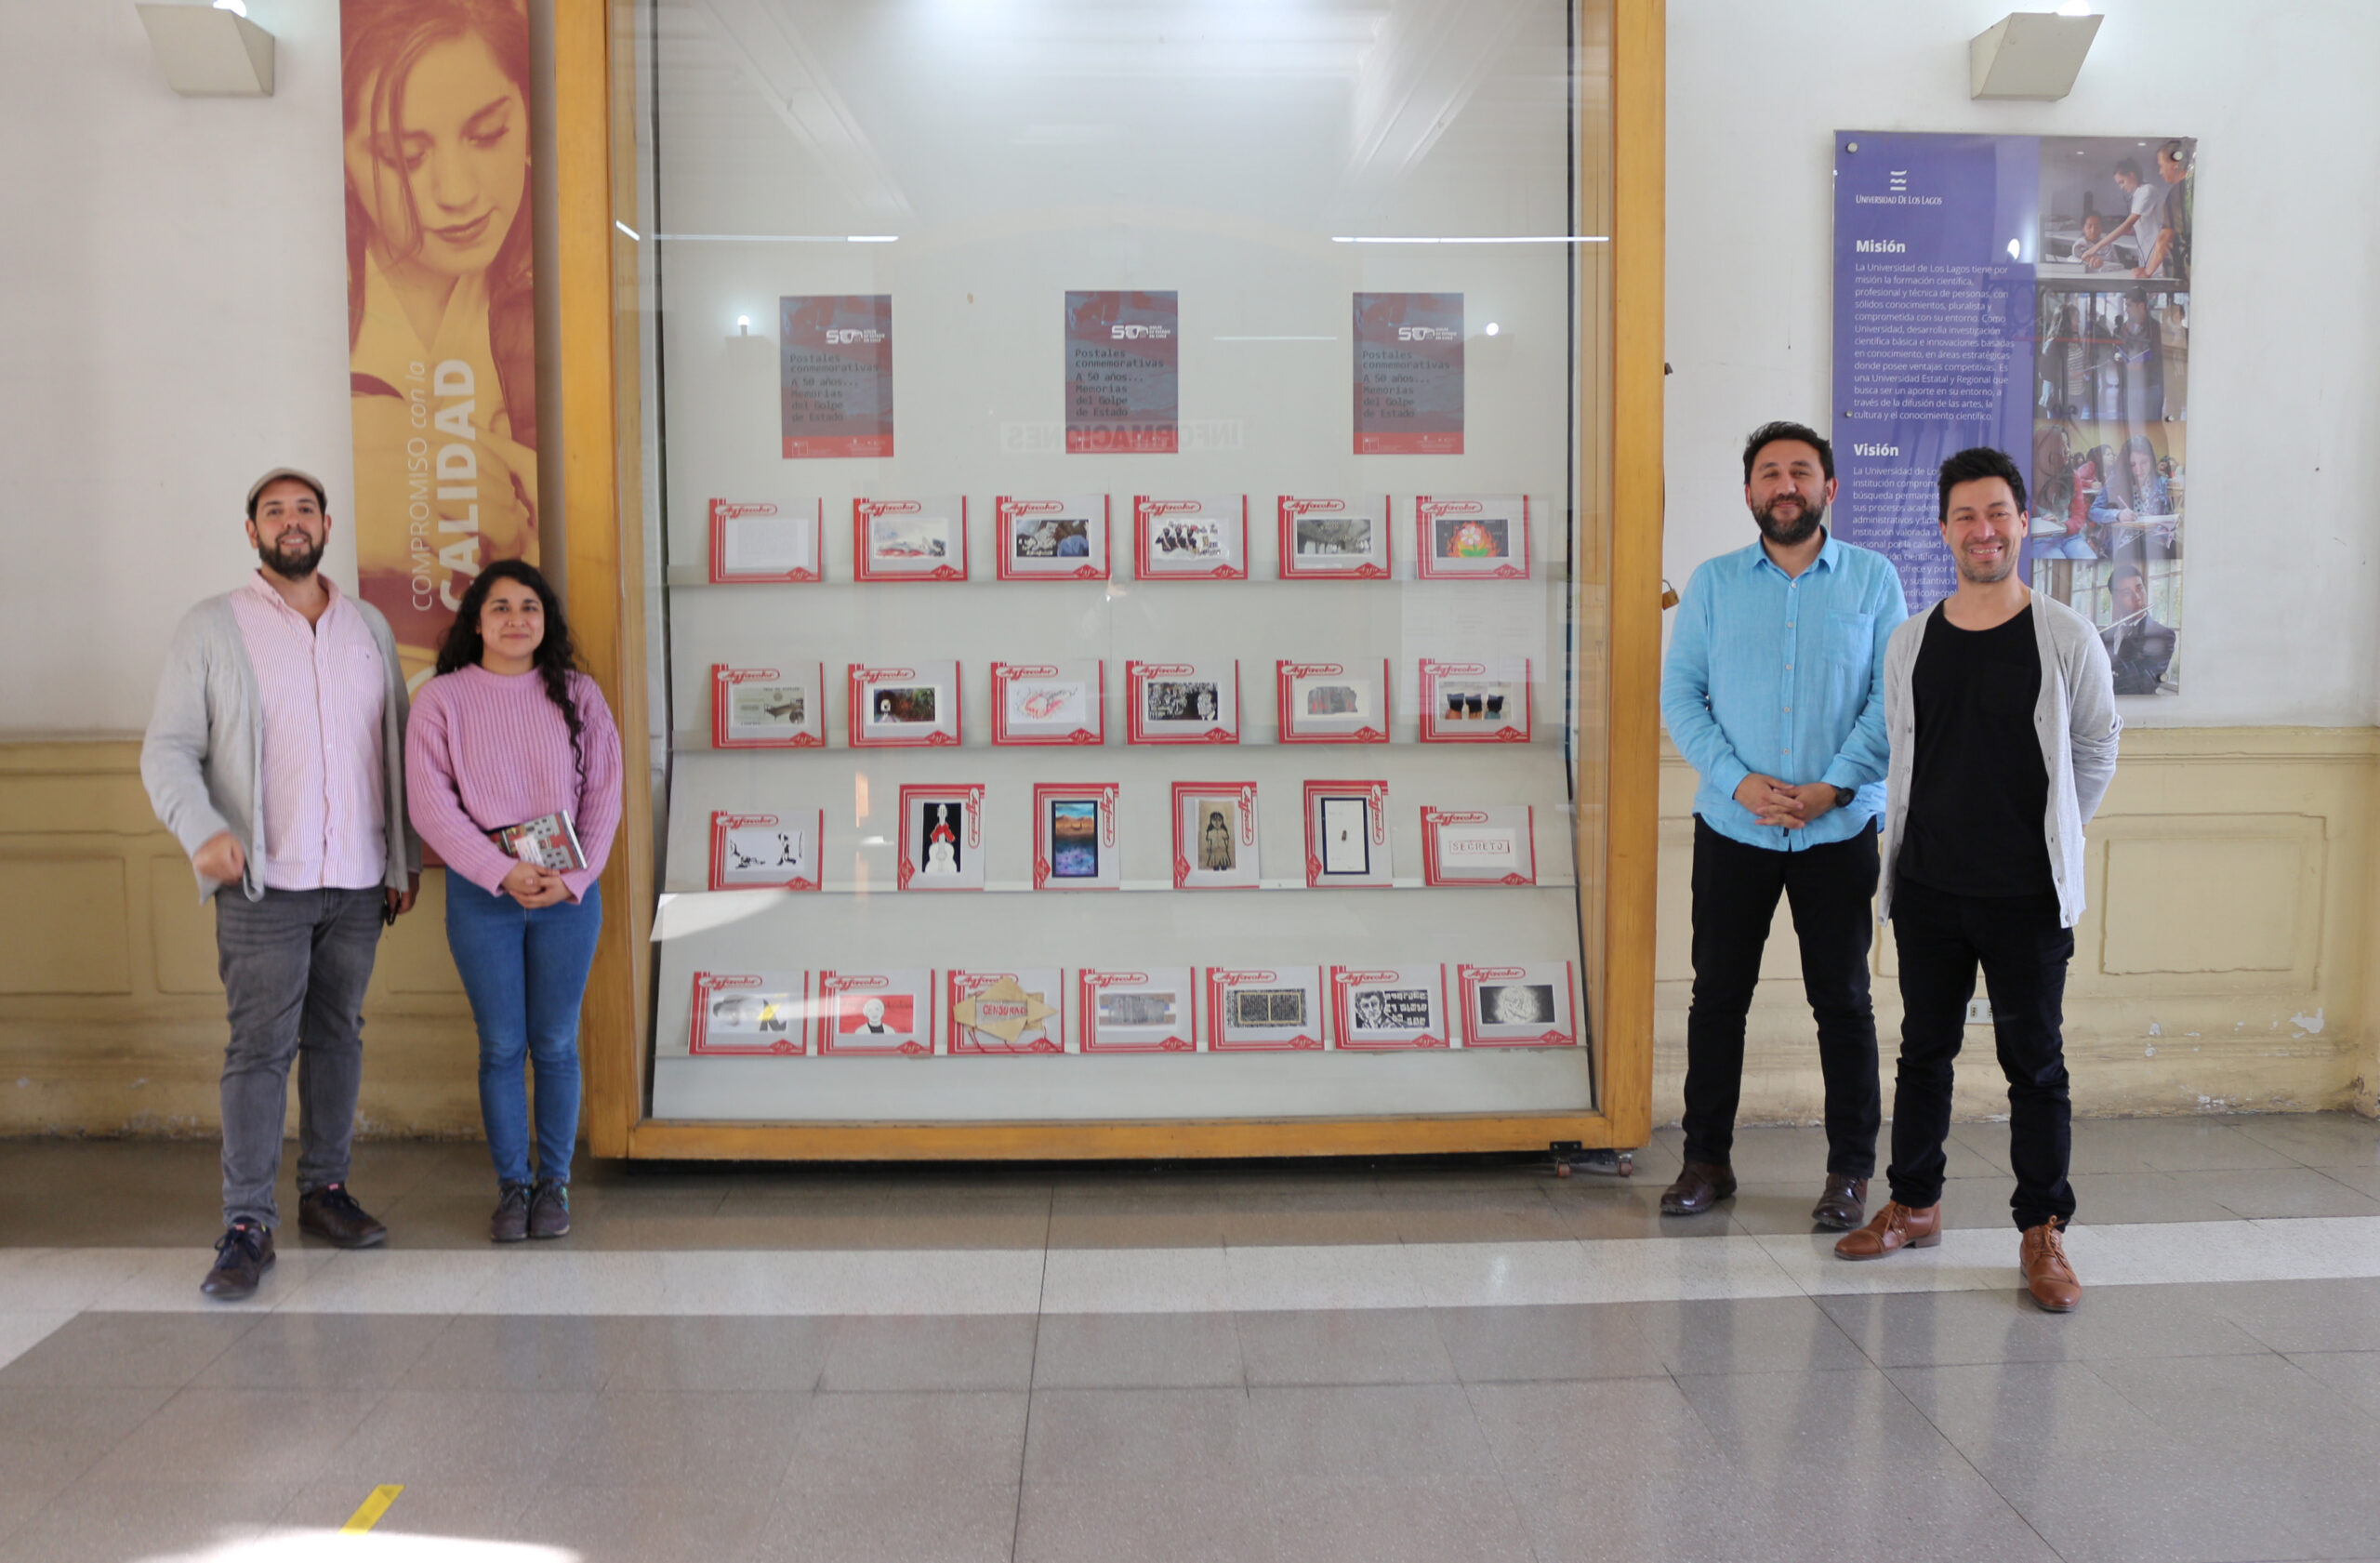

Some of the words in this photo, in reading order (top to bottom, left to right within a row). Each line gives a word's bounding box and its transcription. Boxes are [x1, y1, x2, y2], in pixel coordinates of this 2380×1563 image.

[1856, 239, 1906, 253] Misión
[1917, 264, 1928, 272] de
[1930, 264, 1945, 272] Los
[1947, 265, 1970, 275] Lagos
[1994, 267, 2008, 276] por
[1894, 275, 1935, 285] formación
[1855, 288, 1900, 298] profesional
[1909, 288, 1937, 297] técnica
[1855, 300, 1884, 309] sólidos
[1949, 302, 1985, 311] pluralista
[1855, 312, 1914, 323] comprometida
[1855, 337, 1889, 346] científica
[1075, 349, 1126, 358] Postales
[1075, 359, 1164, 368] conmemorativas
[1883, 364, 1908, 372] posee
[404, 360, 425, 383] la
[1872, 374, 1920, 383] Universidad
[1922, 375, 1948, 383] Estatal
[1957, 376, 1990, 386] Regional
[1076, 385, 1128, 393] Memorias
[1908, 389, 1934, 397] aporte
[1077, 396, 1092, 404] del
[1880, 399, 1891, 407] de
[1902, 399, 1934, 407] difusión
[411, 391, 427, 429] con
[1077, 407, 1088, 417] de
[1093, 408, 1128, 417] Estado
[1854, 411, 1882, 419] cultura
[1899, 412, 1954, 420] conocimiento
[1854, 444, 1899, 457] Visión
[434, 359, 481, 614] CALIDAD
[1853, 491, 1893, 500] búsqueda
[1896, 492, 1940, 502] permanent
[408, 437, 432, 611] COMPROMISO
